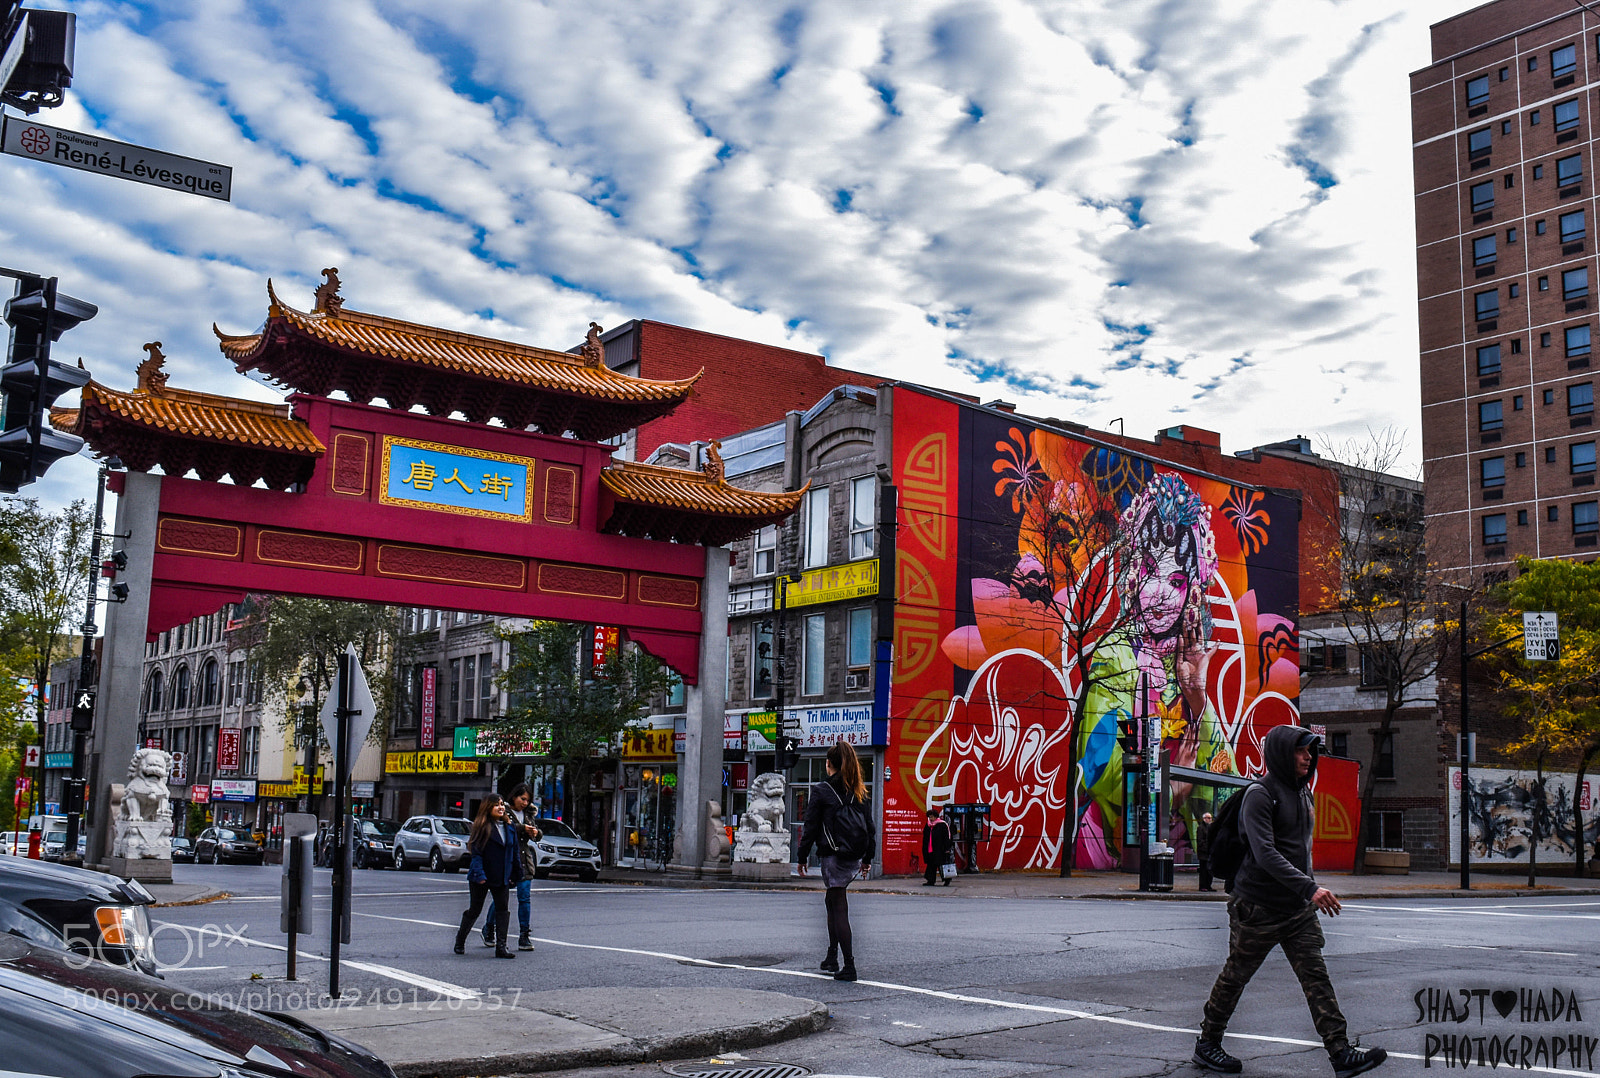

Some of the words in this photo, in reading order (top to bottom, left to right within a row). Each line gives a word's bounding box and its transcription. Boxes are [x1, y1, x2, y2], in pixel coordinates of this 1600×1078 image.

[56, 131, 98, 148] Boulevard
[54, 141, 223, 194] René-Lévesque
[208, 167, 222, 176] est
[402, 460, 514, 501] 唐人街
[1527, 648, 1546, 656] BUS
[424, 690, 433, 714] FUNG
[749, 712, 776, 726] MASSAGE
[806, 710, 818, 723] Tri
[820, 709, 840, 722] Minh
[842, 708, 870, 724] Huynh
[424, 716, 432, 746] SHING
[810, 725, 832, 734] OPTICIEN
[841, 724, 866, 733] QUARTIER
[452, 762, 464, 771] FUNG
[464, 762, 478, 771] SHING
